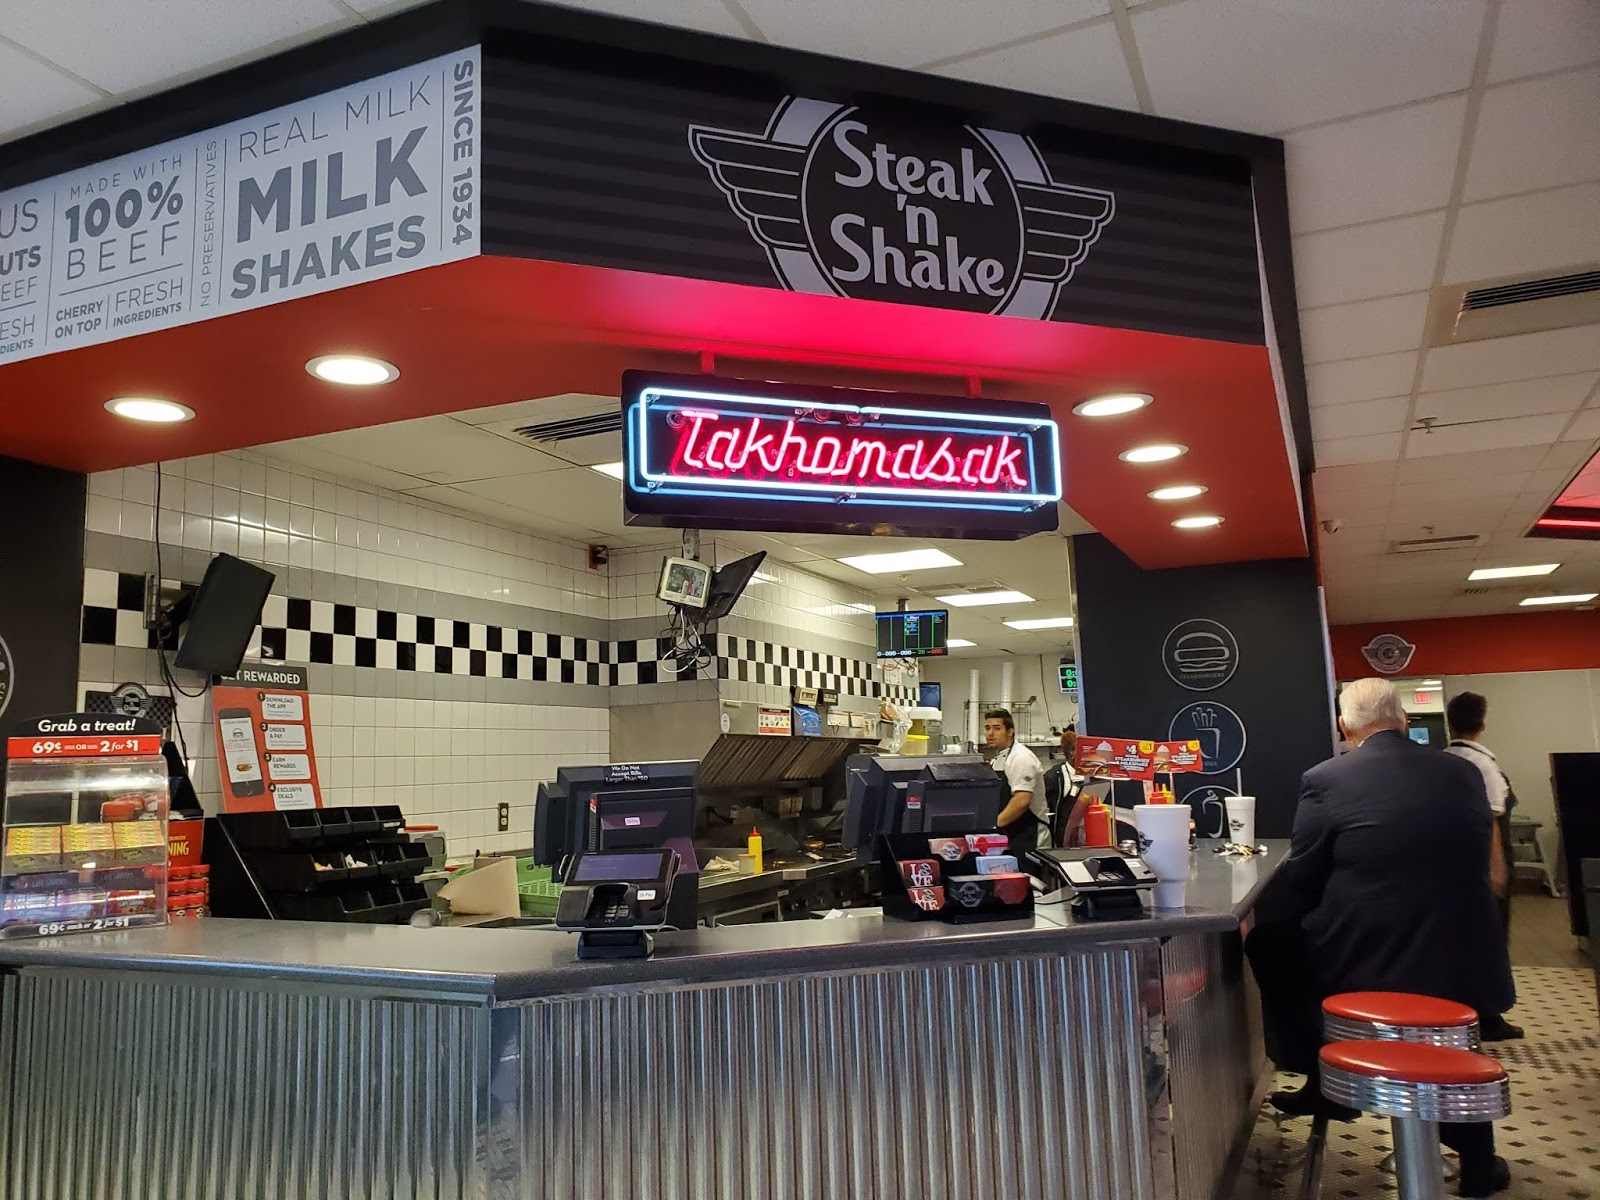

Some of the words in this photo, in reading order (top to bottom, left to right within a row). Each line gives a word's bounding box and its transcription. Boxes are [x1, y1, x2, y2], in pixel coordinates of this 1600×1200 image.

[238, 112, 328, 162] REAL
[345, 75, 431, 132] MILK
[453, 59, 474, 162] SINCE
[70, 173, 121, 201] MADE
[133, 154, 182, 181] WITH
[237, 125, 429, 244] MILK
[832, 119, 995, 207] Steak
[65, 175, 183, 244] 100%
[203, 140, 218, 278] PRESERVATIVES
[452, 166, 473, 246] 1934
[896, 193, 939, 246] 'n
[67, 221, 180, 281] BEEF
[230, 215, 426, 300] SHAKES
[830, 213, 1006, 297] Shake
[56, 300, 103, 322] CHERRY
[113, 302, 182, 328] INGREDIENTS
[115, 276, 183, 312] FRESH
[200, 281, 212, 307] NO
[54, 324, 73, 339] ON
[77, 318, 102, 334] TOP
[681, 409, 1028, 488] Takhomasak
[244, 670, 301, 685] REWARDED
[32, 741, 62, 754] 69¢
[100, 740, 110, 753] 2
[110, 743, 125, 752] for
[126, 739, 139, 751] $1
[38, 719, 77, 732] Grab
[81, 722, 91, 731] a
[94, 718, 136, 731] treat!
[1126, 744, 1138, 755] $4
[93, 919, 102, 930] 2
